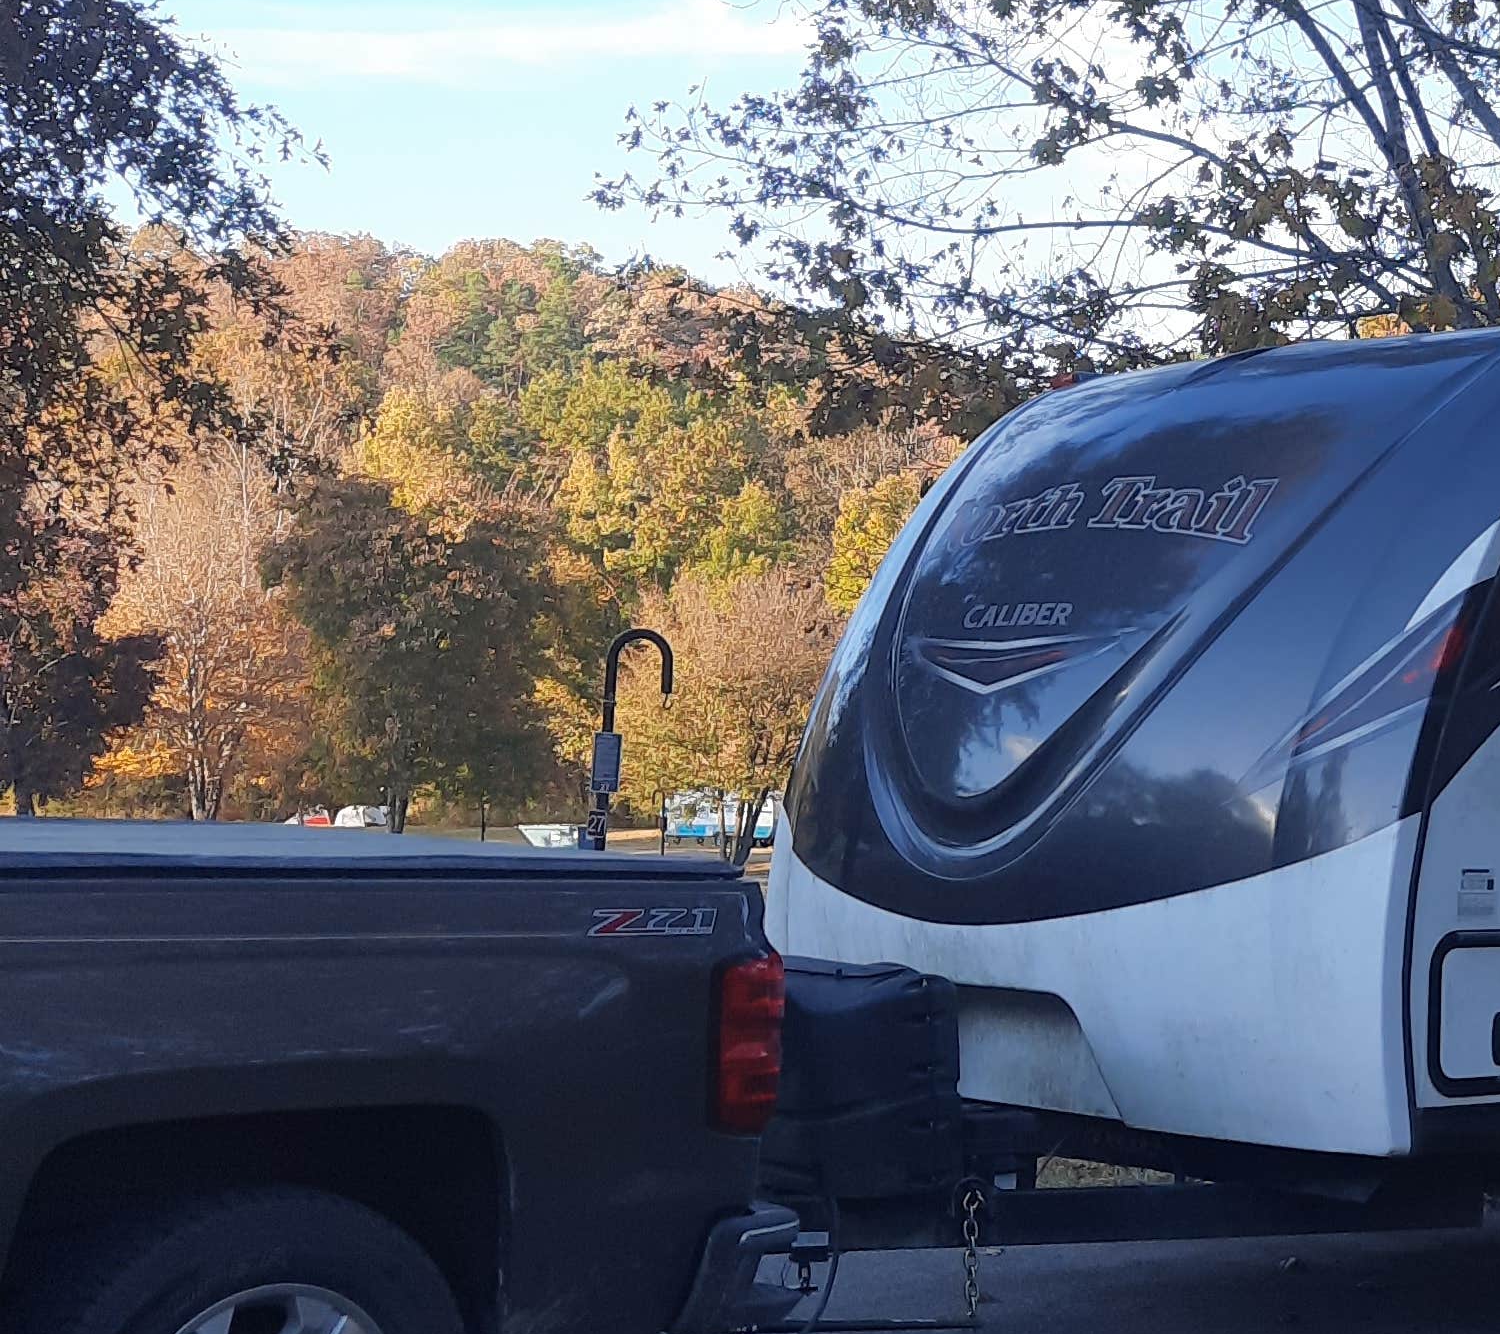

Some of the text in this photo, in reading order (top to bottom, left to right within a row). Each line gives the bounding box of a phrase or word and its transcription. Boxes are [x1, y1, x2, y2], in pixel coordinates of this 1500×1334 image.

[1087, 474, 1280, 545] Trail
[962, 602, 1073, 629] CALIBER
[588, 814, 606, 835] 27
[587, 908, 718, 937] Z71
